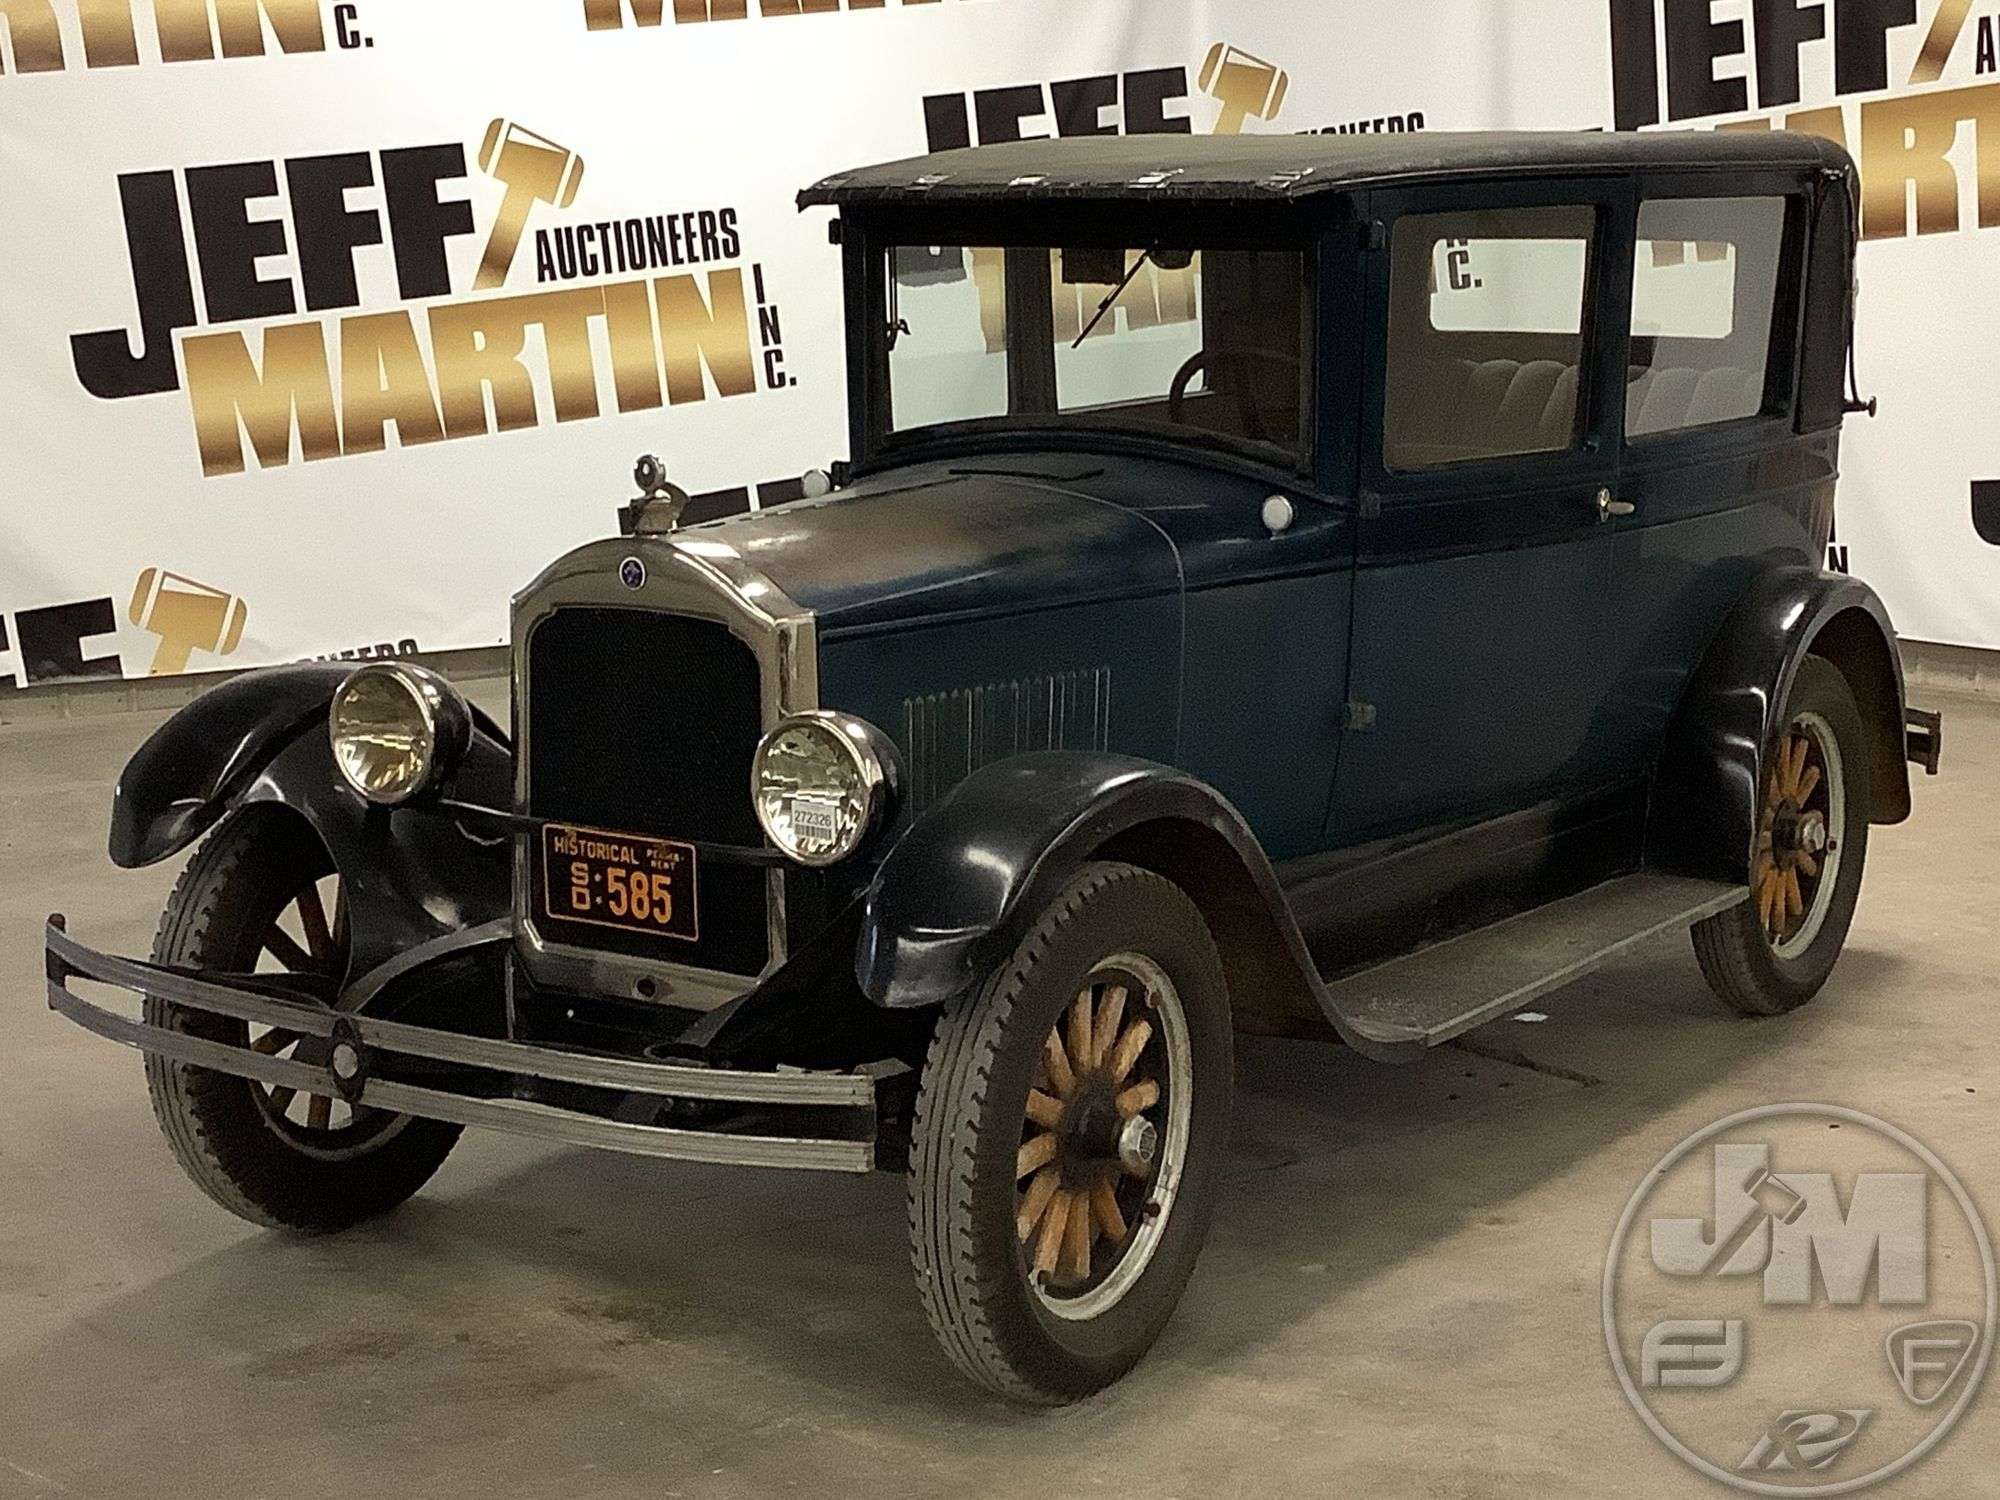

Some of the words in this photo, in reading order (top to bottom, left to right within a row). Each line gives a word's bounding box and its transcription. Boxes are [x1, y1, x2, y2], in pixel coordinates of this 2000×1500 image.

[69, 142, 475, 399] JEFF
[535, 207, 741, 282] AUCTIONEERS
[181, 267, 757, 478] MARTIN
[554, 836, 640, 865] HISTORICAL
[607, 866, 672, 924] 585
